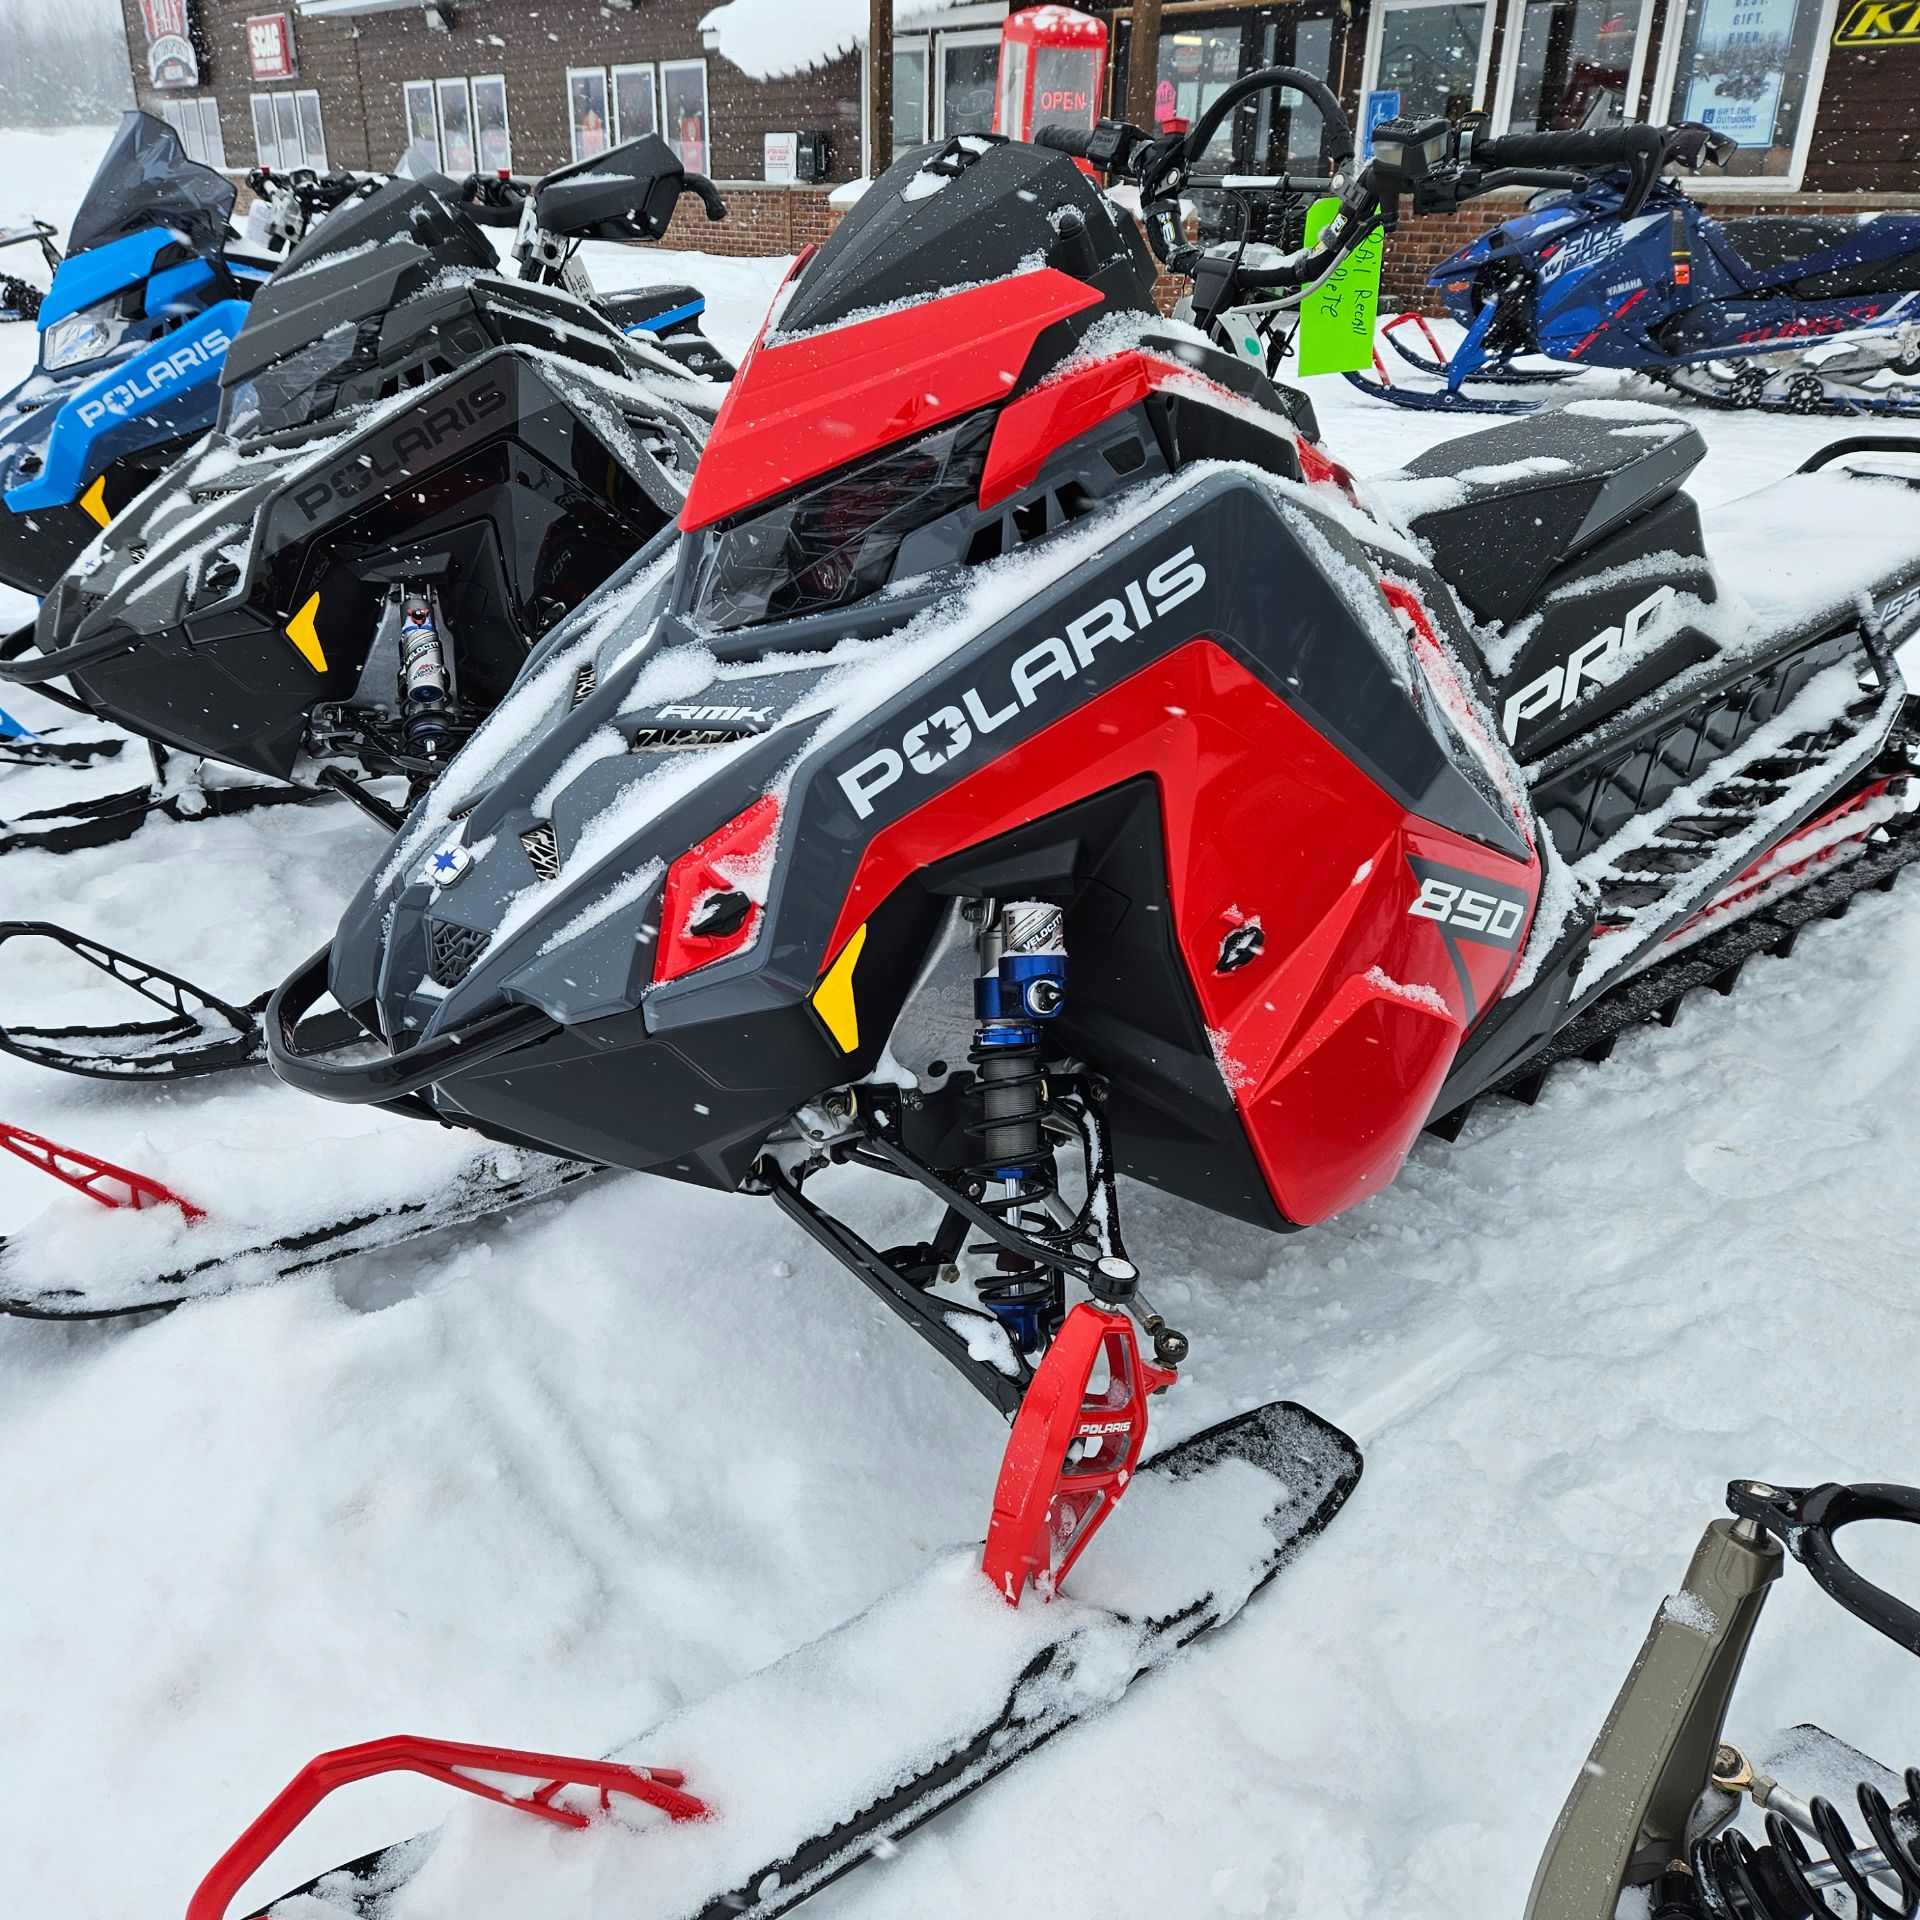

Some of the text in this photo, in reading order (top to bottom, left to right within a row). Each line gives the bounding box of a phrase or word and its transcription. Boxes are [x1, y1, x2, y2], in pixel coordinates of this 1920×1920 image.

[1733, 12, 1764, 26] GIFT.
[1728, 31, 1762, 44] EVER.
[1040, 91, 1087, 112] OPEN
[1606, 277, 1644, 297] YAMAHA
[76, 328, 233, 429] POLARIS
[294, 380, 507, 522] POLARIS
[837, 545, 1207, 820] POLARIS
[655, 705, 776, 722] RMK
[1407, 878, 1524, 939] 850
[1078, 1421, 1132, 1435] POLARIS
